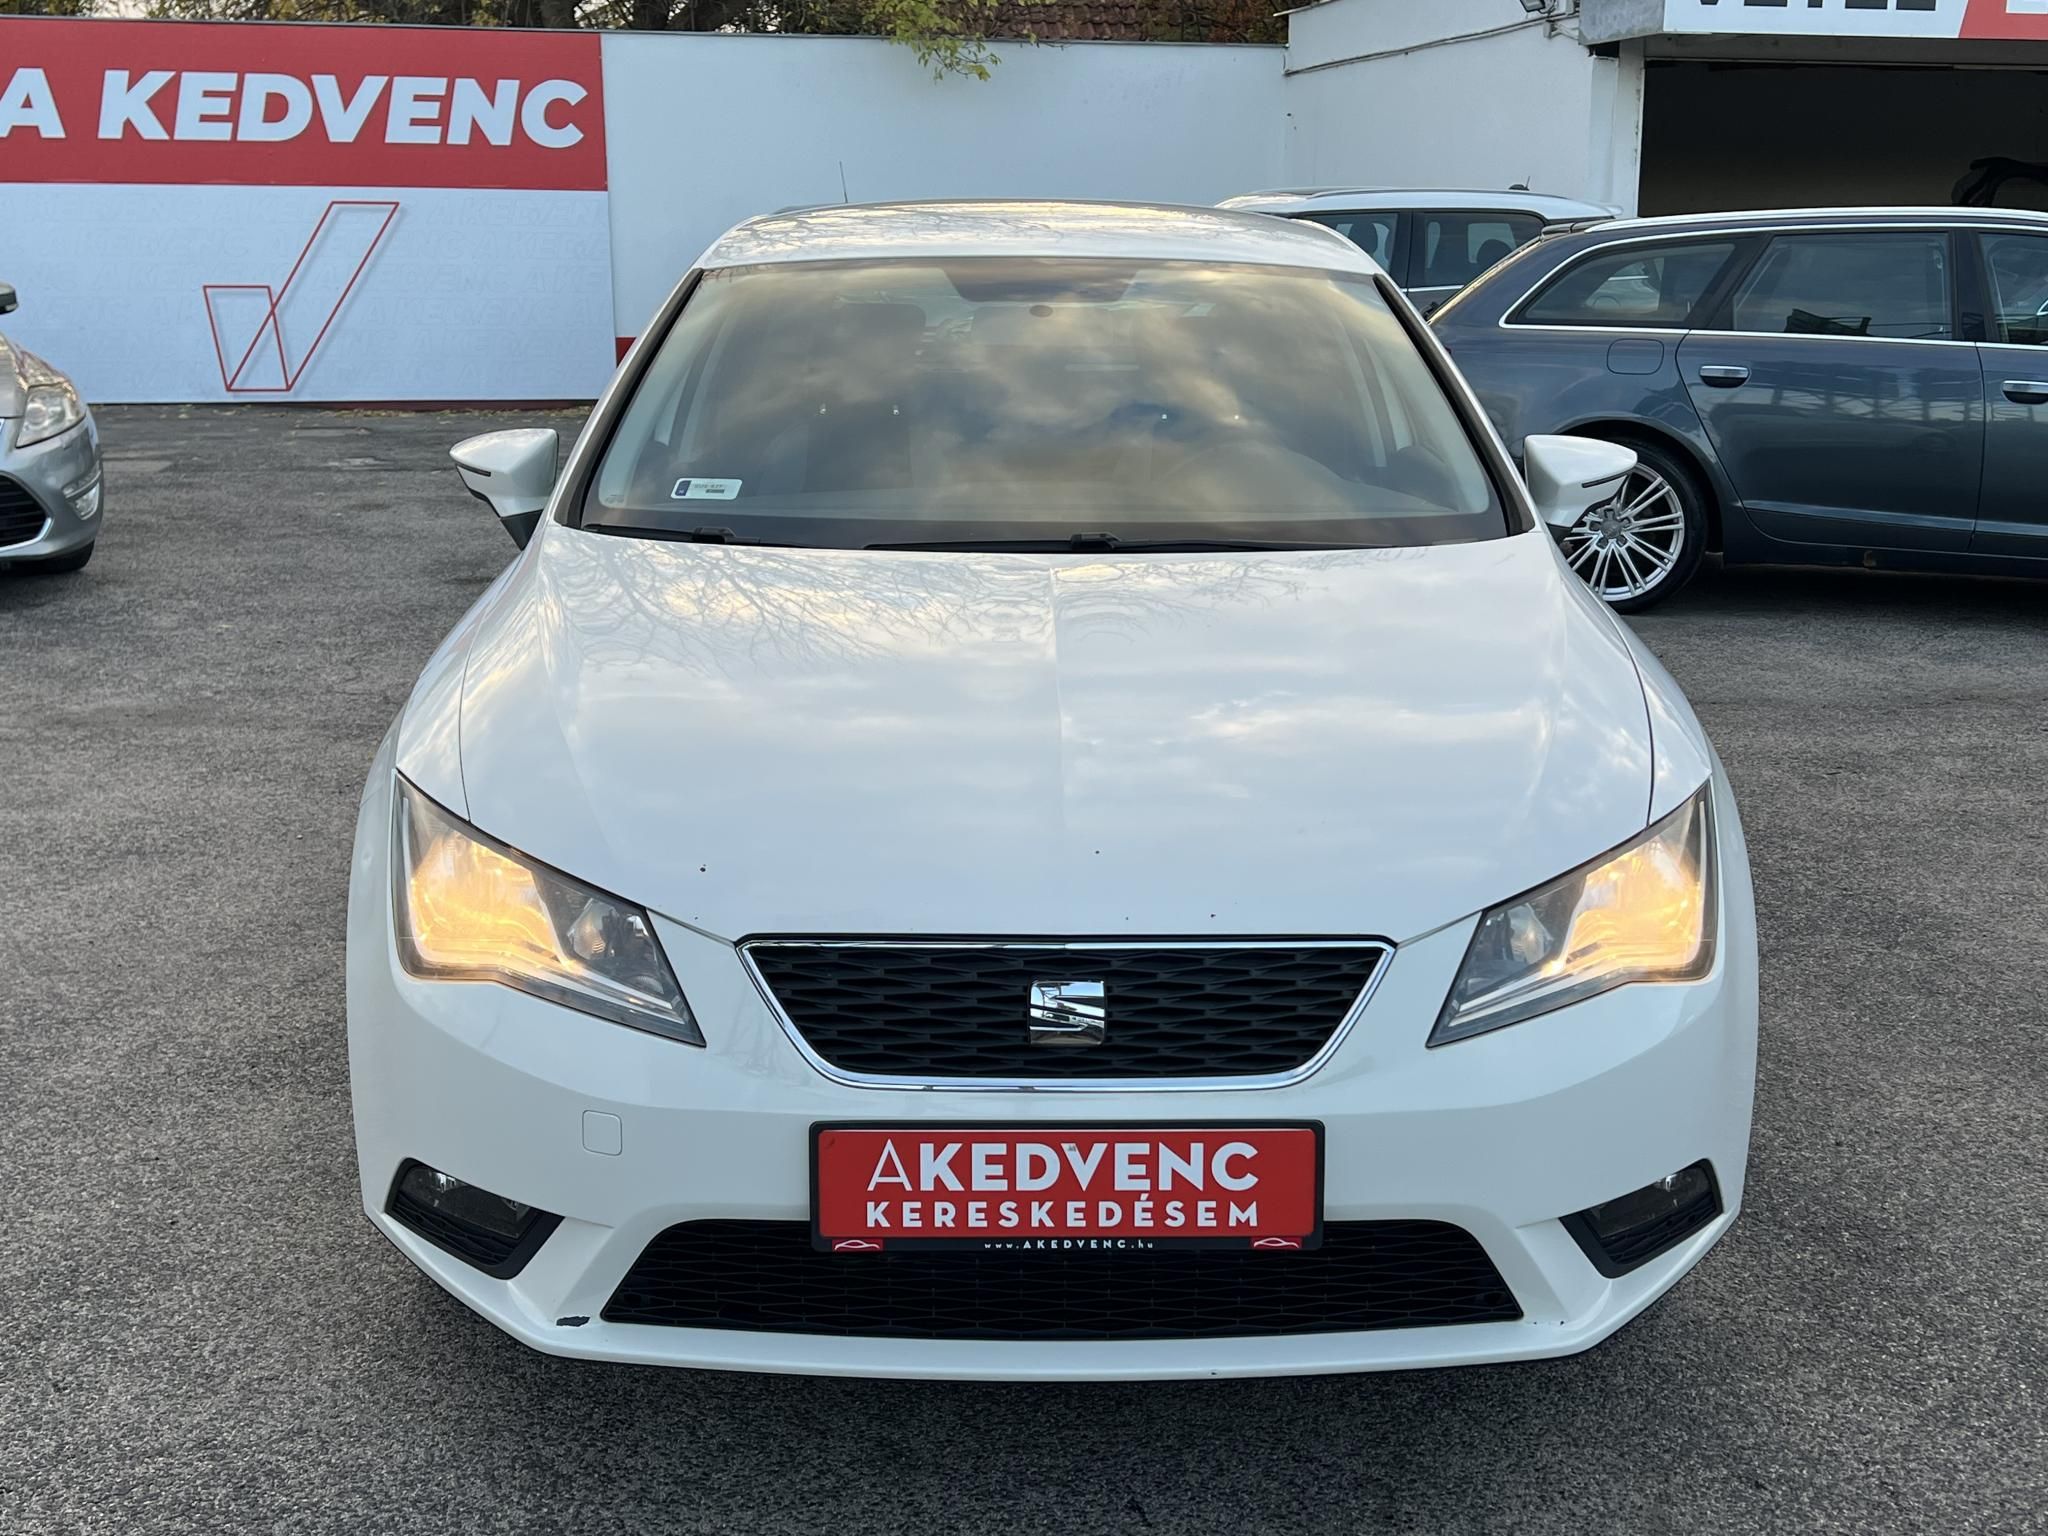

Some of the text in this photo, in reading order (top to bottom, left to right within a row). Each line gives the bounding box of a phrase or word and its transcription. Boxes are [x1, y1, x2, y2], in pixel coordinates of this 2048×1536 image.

[0, 67, 589, 149] A KEDVENC
[867, 1138, 1259, 1192] AKEDVENC
[866, 1192, 1258, 1228] KERESKEDÉSEM
[984, 1239, 1153, 1249] www.AKEDVENC.hu
